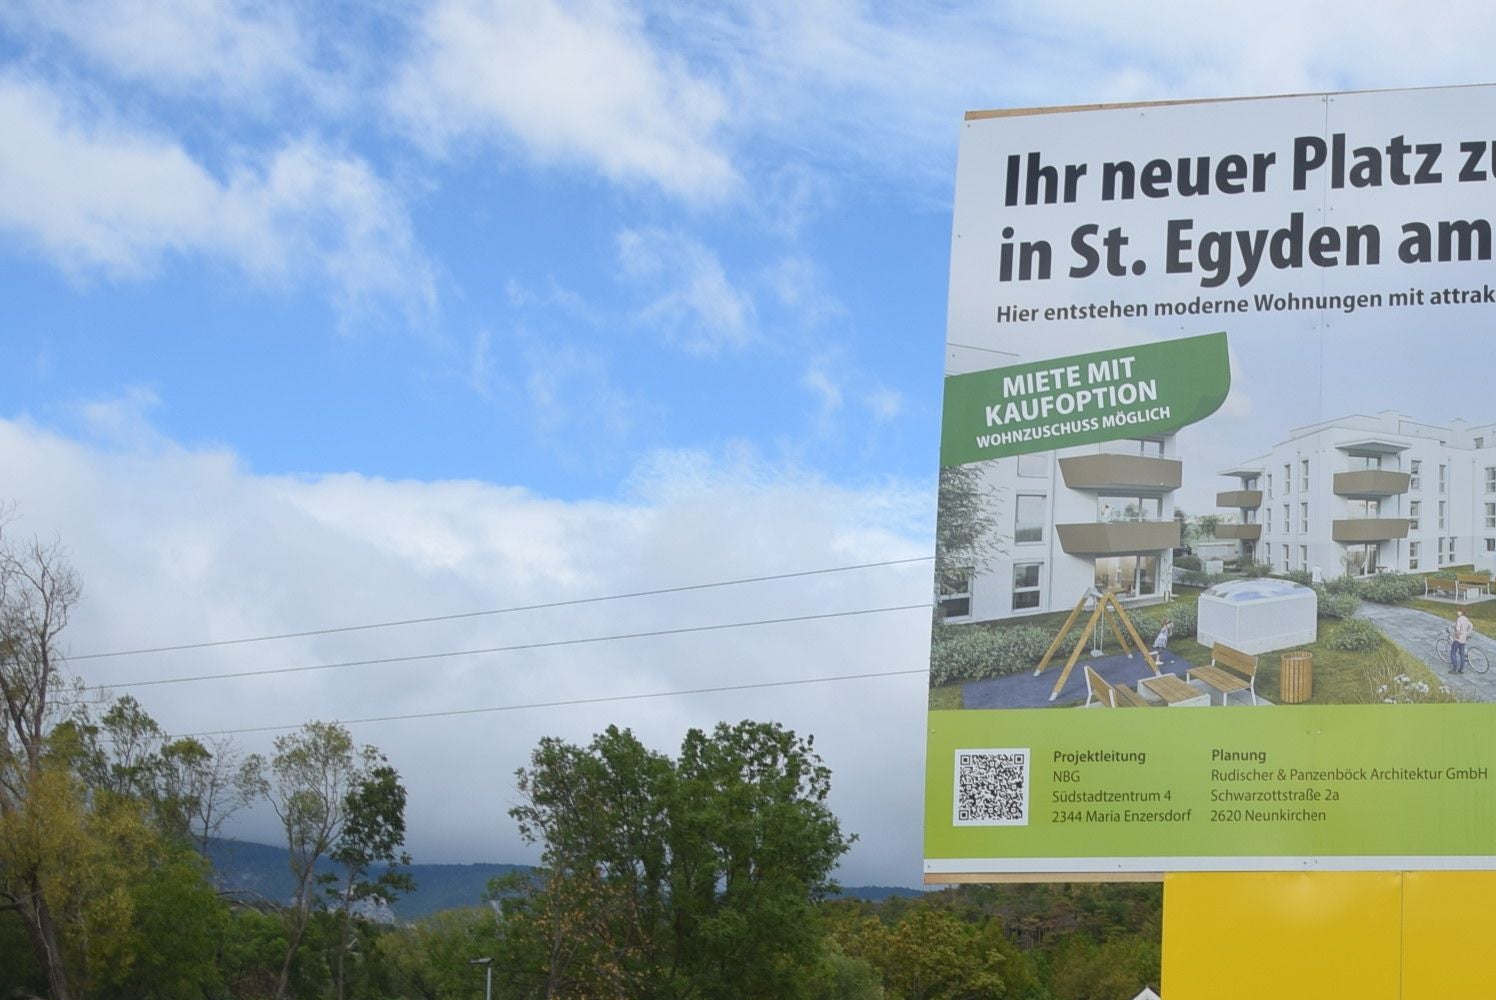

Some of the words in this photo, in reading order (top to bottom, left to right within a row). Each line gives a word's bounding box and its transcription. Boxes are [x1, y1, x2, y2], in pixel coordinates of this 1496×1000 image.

[1005, 153, 1086, 207] Ihr
[1102, 153, 1275, 201] neuer
[1294, 133, 1442, 190] Platz
[999, 228, 1051, 282] in
[1069, 223, 1145, 278] St.
[1166, 212, 1381, 287] Egyden
[1398, 210, 1491, 264] am
[997, 304, 1039, 323] Hier
[1044, 301, 1148, 320] entstehen
[1154, 296, 1249, 316] moderne
[1254, 290, 1382, 317] Wohnungen
[1389, 289, 1425, 307] mit
[1003, 365, 1081, 398] MIETE
[1088, 356, 1135, 384] MIT
[985, 379, 1157, 427] KAUFOPTION
[976, 418, 1099, 448] WOHNZUSCHUSS
[1102, 406, 1170, 428] MÖGLICH
[1054, 749, 1146, 765] Projektleitung
[1212, 749, 1266, 764] Planung
[1053, 771, 1080, 782] NBG
[1211, 769, 1273, 781] Rudischer
[1277, 770, 1286, 780] &
[1290, 768, 1366, 781] Panzenböck
[1370, 768, 1442, 780] Architektur
[1446, 767, 1488, 779] GmbH
[1052, 789, 1160, 802] Südstadtzentrum
[1164, 790, 1171, 801] 4
[1211, 789, 1321, 801] Schwarzottstraße
[1325, 790, 1338, 800] 2a
[1052, 811, 1082, 822] 2344
[1086, 810, 1121, 822] Maria
[1124, 809, 1191, 821] Enzersdorf
[1211, 810, 1241, 822] 2620
[1245, 809, 1326, 822] Neunkirchen
